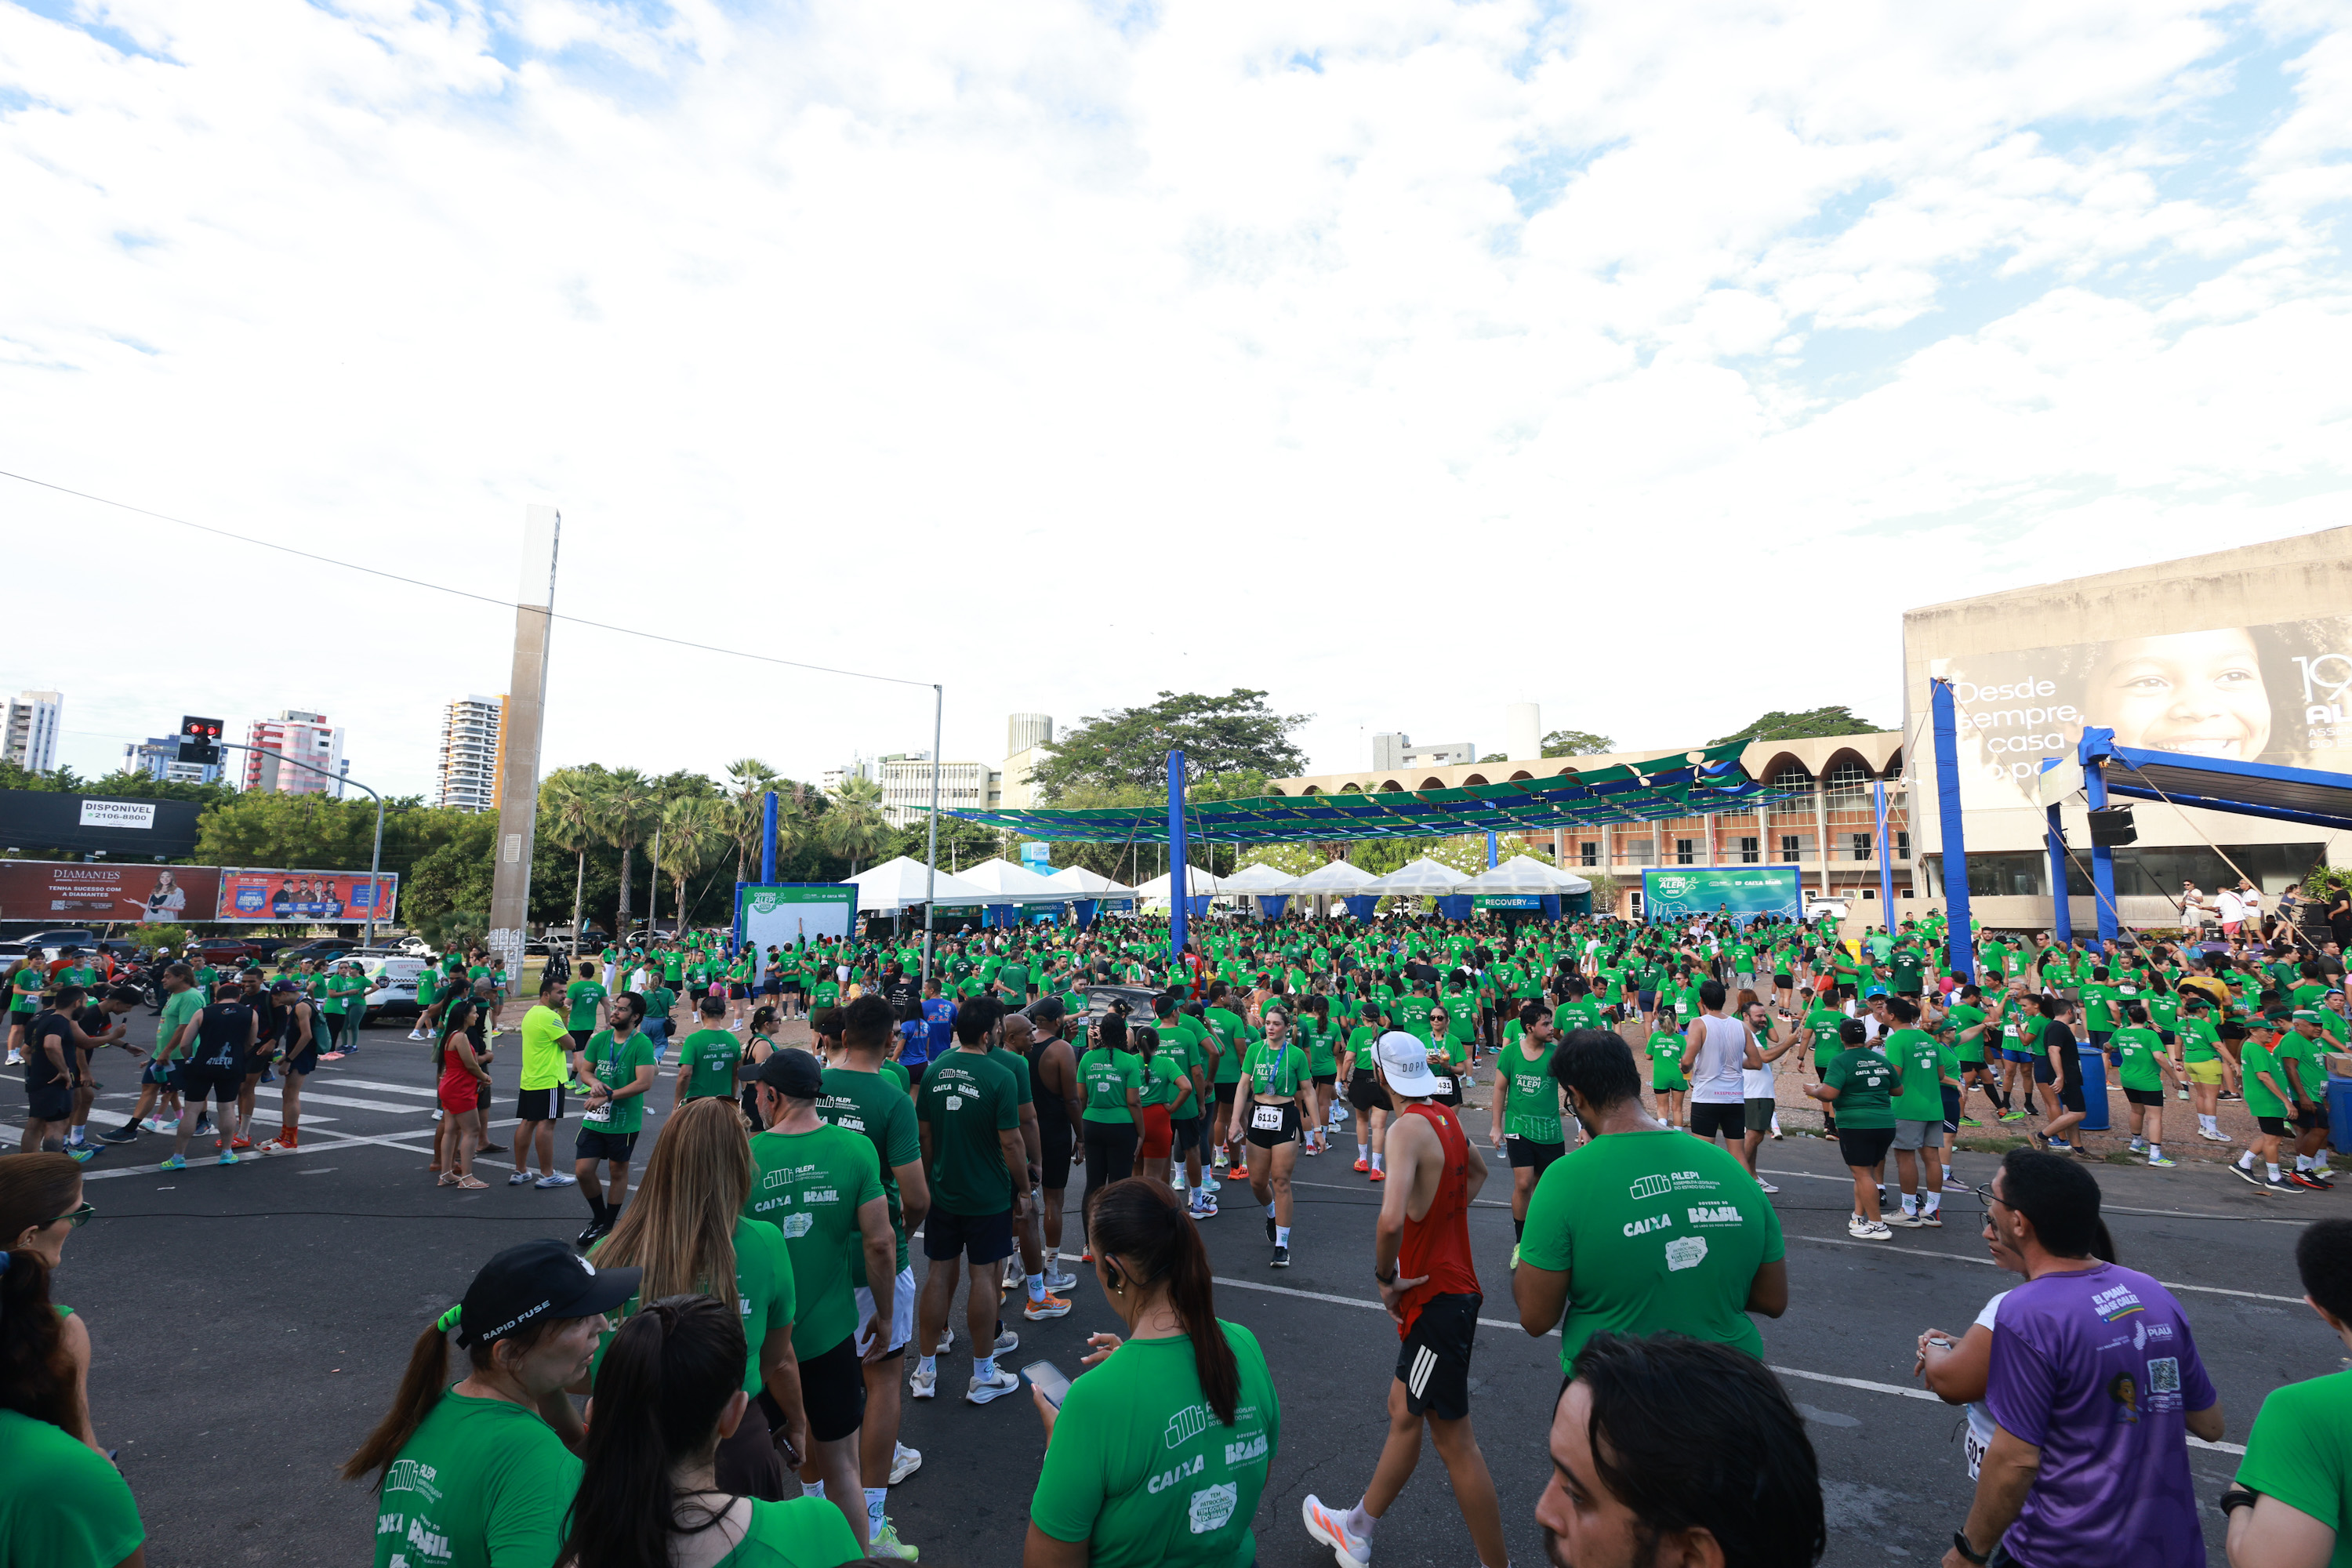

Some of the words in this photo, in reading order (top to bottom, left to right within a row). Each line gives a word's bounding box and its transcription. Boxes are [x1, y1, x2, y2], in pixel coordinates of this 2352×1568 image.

[1957, 676, 2056, 703] Desde
[1962, 705, 2085, 730] sempre,
[1987, 732, 2065, 753] casa
[2011, 762, 2043, 784] po
[85, 803, 151, 813] DISPONÍVEL
[53, 869, 121, 879] DIAMANTES
[1030, 903, 1058, 912] ALIMENTAÇÃO
[1403, 1061, 1425, 1073] DOPA
[933, 1083, 952, 1092] CAIXA
[958, 1084, 980, 1098] BRASIL
[1516, 1079, 1541, 1089] ALEPI
[837, 1117, 866, 1131] BRASIL
[1258, 1113, 1278, 1123] 6119
[795, 1164, 815, 1174] ALEPI
[1671, 1171, 1700, 1181] ALEPI
[754, 1195, 791, 1212] CAIXA
[804, 1190, 839, 1203] BRASIL
[1687, 1207, 1743, 1223] BRASIL
[1623, 1214, 1672, 1237] CAIXA
[483, 1320, 516, 1341] RAPID
[517, 1300, 551, 1323] FUSE
[1236, 1430, 1258, 1439] GOVERNO
[1225, 1434, 1269, 1465] BRASIL
[419, 1464, 437, 1483] ALEPI
[1147, 1454, 1204, 1494] CAIXA
[1198, 1507, 1209, 1516] TEM
[1209, 1501, 1232, 1513] GOVERNO
[1200, 1495, 1229, 1508] PATROCÍNIO
